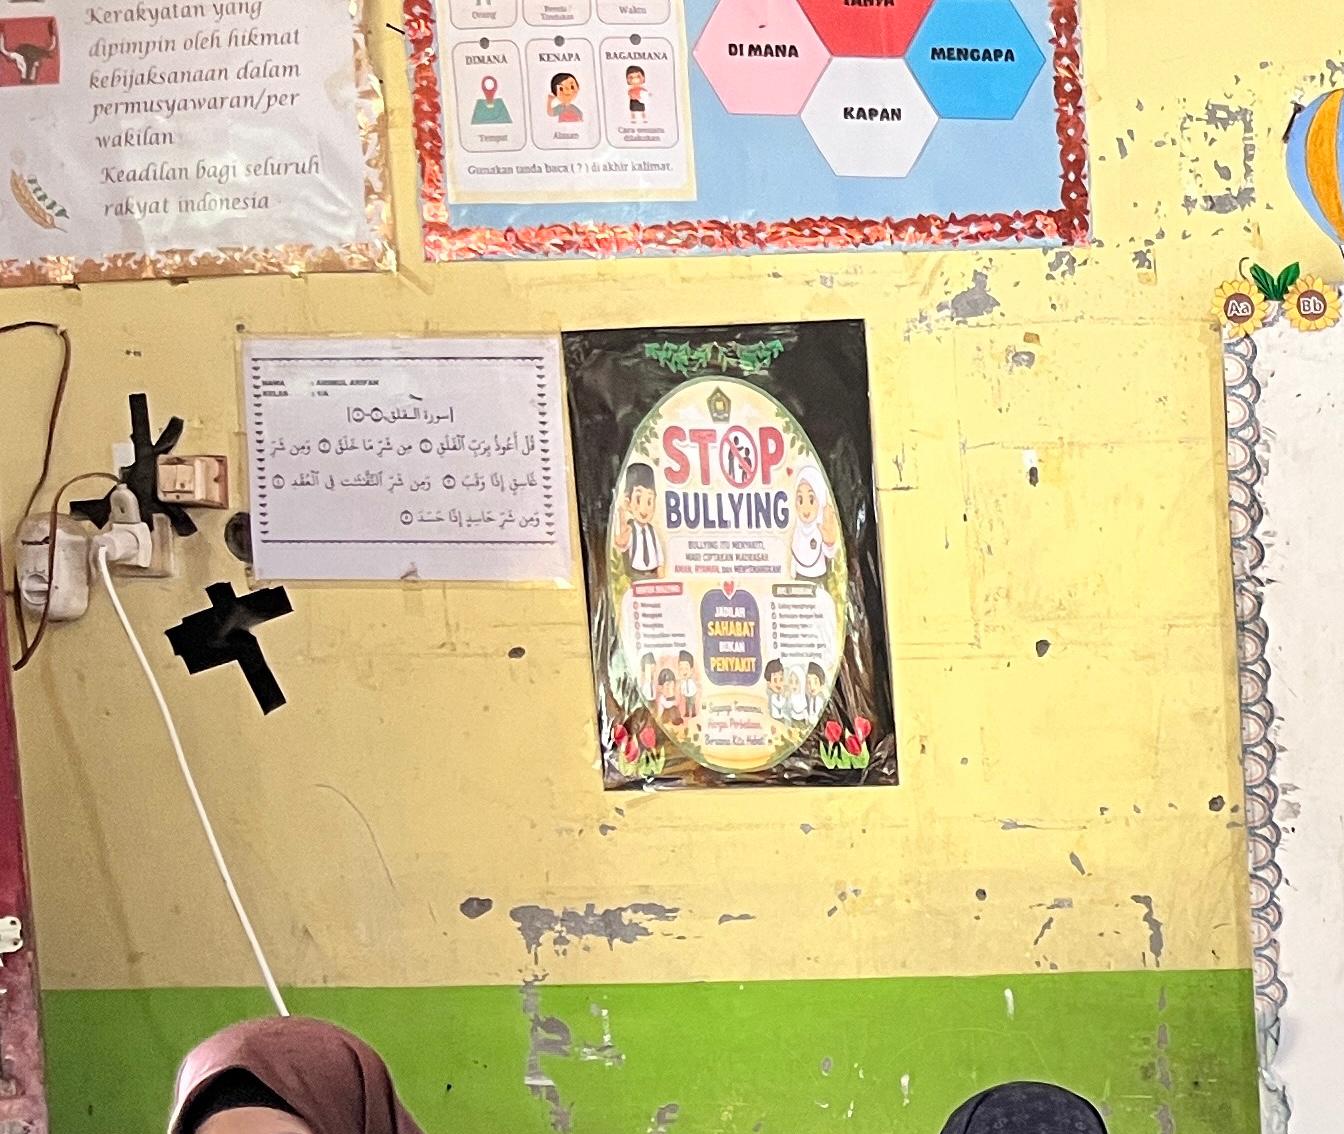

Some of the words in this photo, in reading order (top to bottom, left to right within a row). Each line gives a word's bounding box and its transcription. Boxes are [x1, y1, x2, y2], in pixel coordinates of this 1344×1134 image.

[84, 2, 205, 27] Kerakyatan
[213, 0, 262, 22] yang
[88, 35, 176, 62] dipimpin
[183, 29, 220, 50] oleh
[227, 27, 300, 48] hikmat
[728, 44, 744, 57] DI
[748, 44, 799, 58] MANA
[465, 55, 508, 65] DIMANA
[539, 53, 581, 63] KENAPA
[605, 52, 668, 61] BAGAIMANA
[931, 47, 1015, 63] MENGAPA
[89, 65, 229, 93] kebijaksanaan
[236, 59, 301, 81] dalam
[843, 107, 902, 121] KAPAN
[95, 126, 173, 148] wakilan
[100, 161, 189, 184] Keadilan
[196, 159, 237, 185] bagi
[245, 154, 320, 177] seluruh
[468, 165, 513, 175] Gunakan
[515, 164, 542, 174] tanda
[544, 163, 569, 173] baca
[602, 162, 628, 173] akhir
[104, 196, 169, 219] rakyat
[178, 191, 269, 213] indonesia
[1227, 300, 1251, 316] Aa
[1300, 297, 1324, 314] Bb
[662, 425, 786, 489] STOP
[664, 490, 790, 530] BULLYING
[707, 621, 755, 638] SAHABAT
